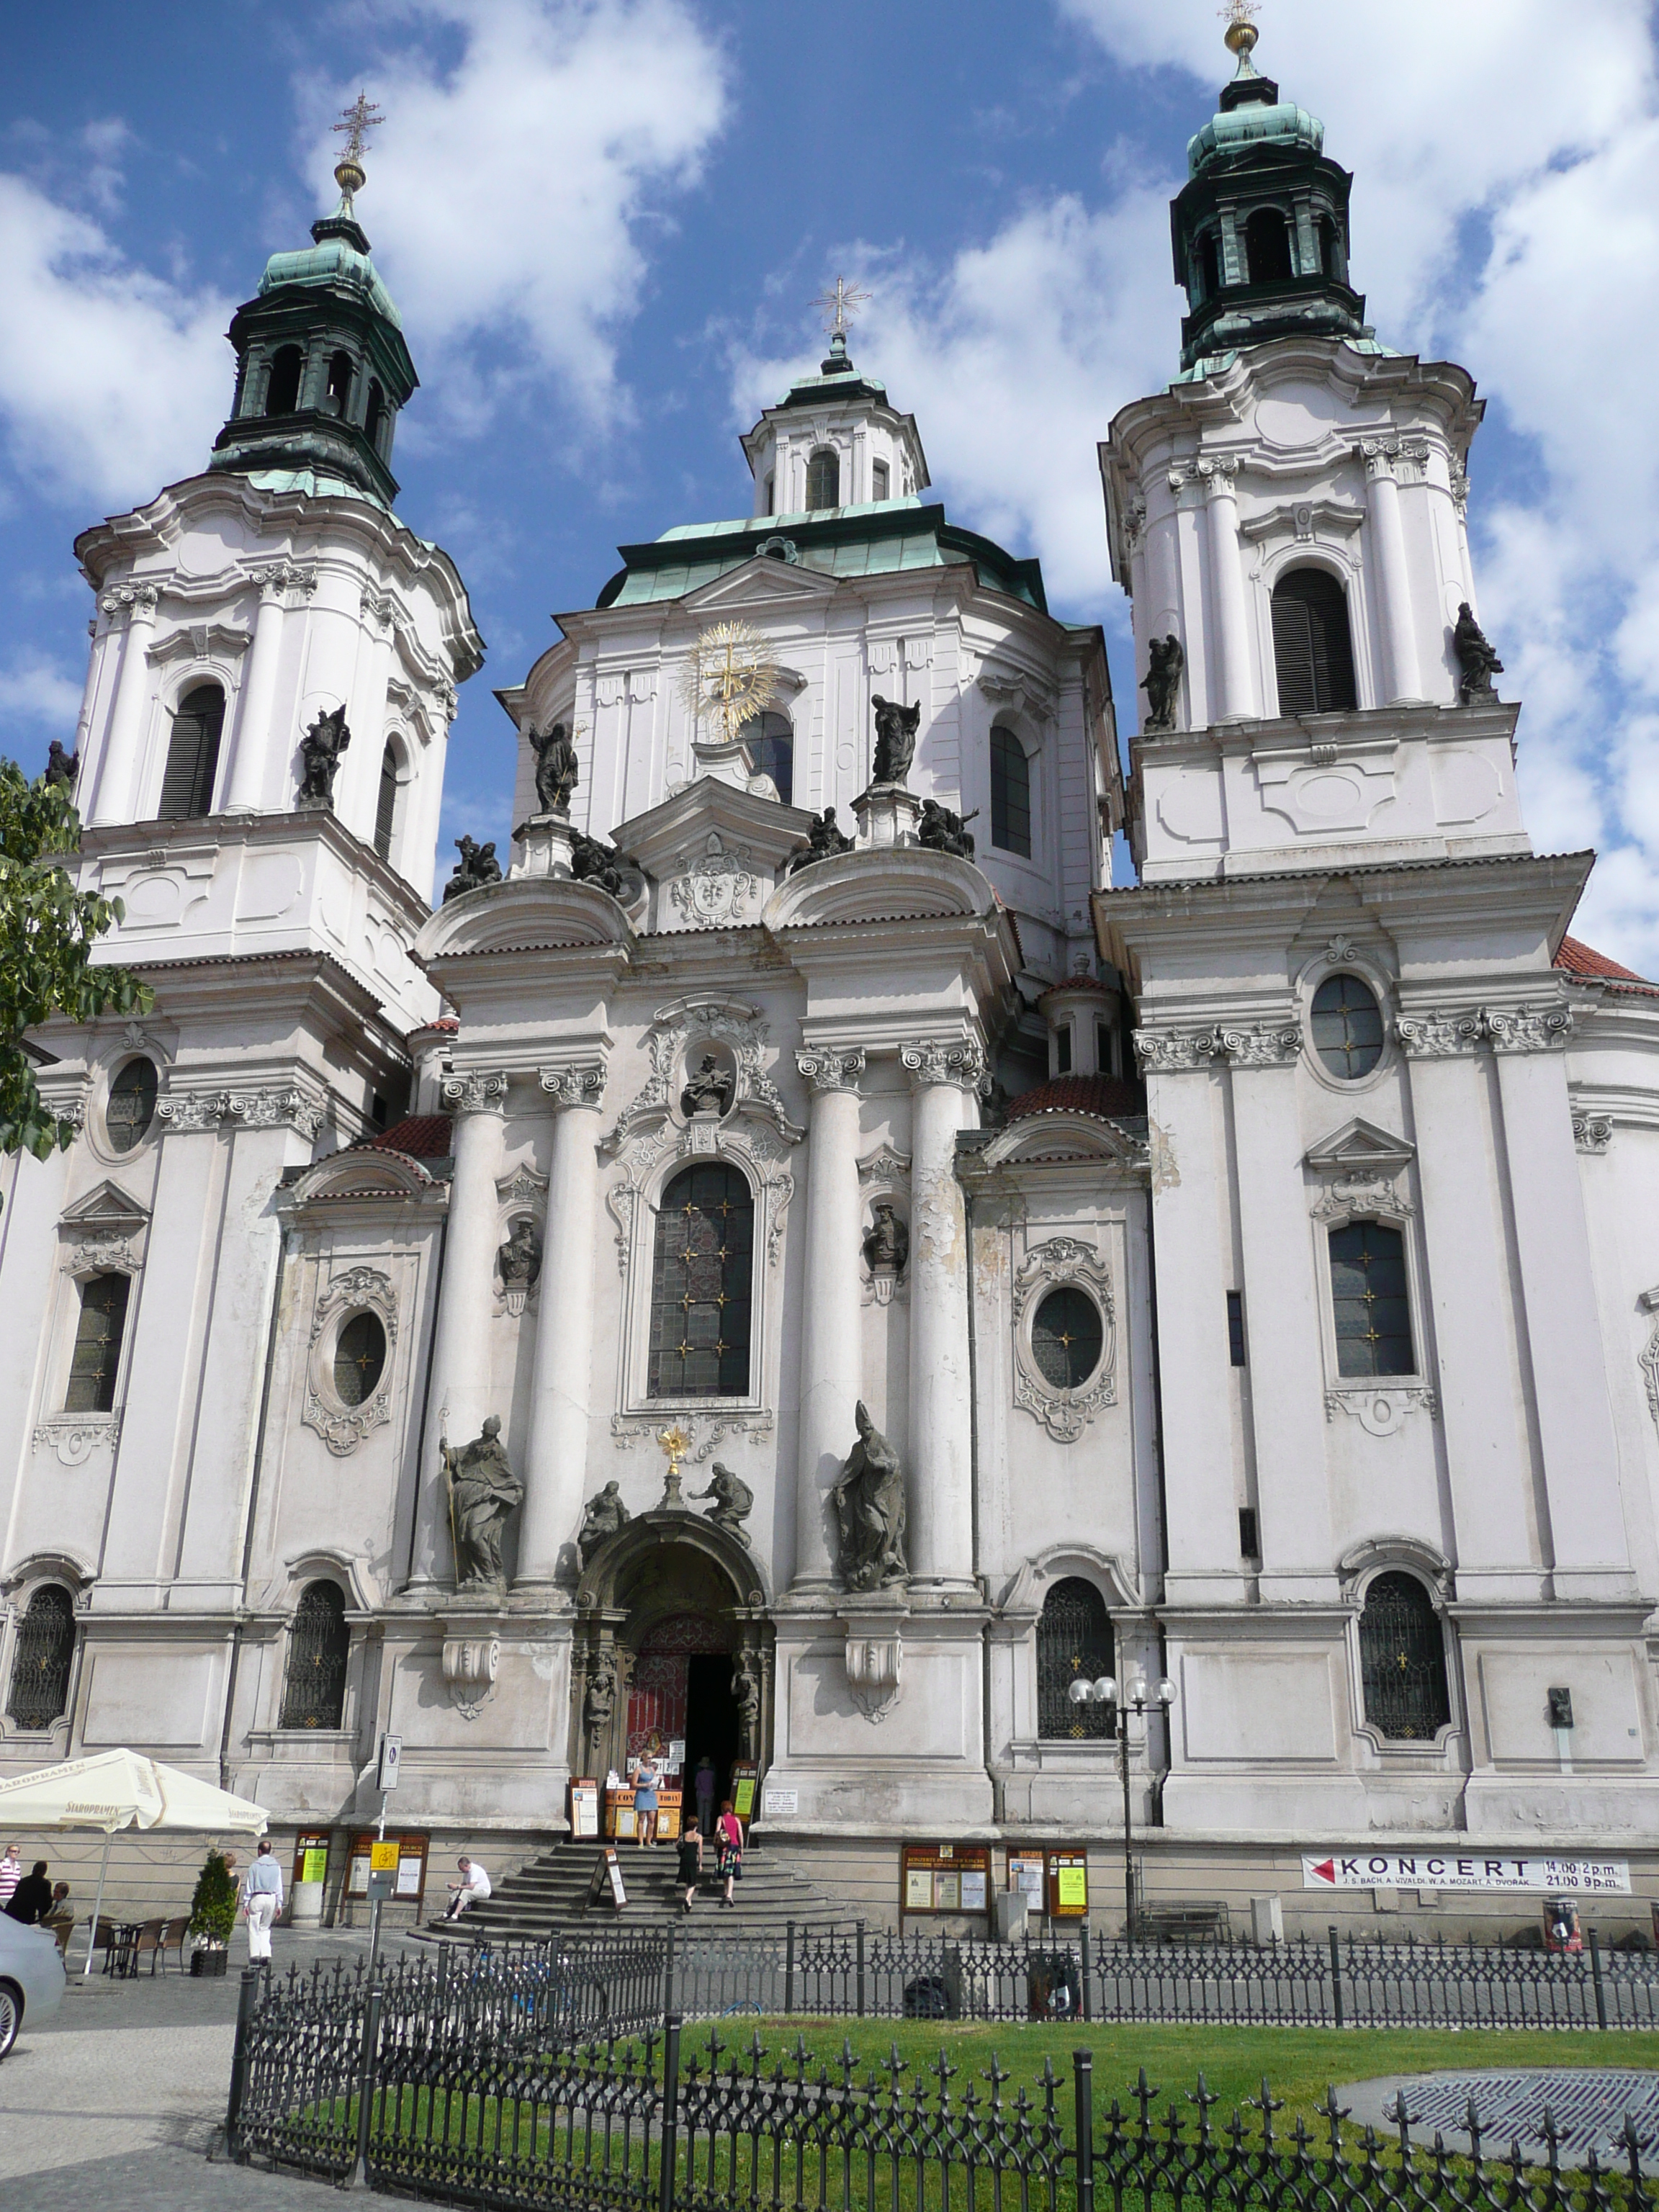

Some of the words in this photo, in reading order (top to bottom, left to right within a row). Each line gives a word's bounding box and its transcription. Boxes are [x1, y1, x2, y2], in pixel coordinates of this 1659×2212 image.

[66, 1801, 120, 1816] STAROPRAMEN
[1341, 1857, 1529, 1877] KONCERT
[1546, 1861, 1576, 1874] 14.00
